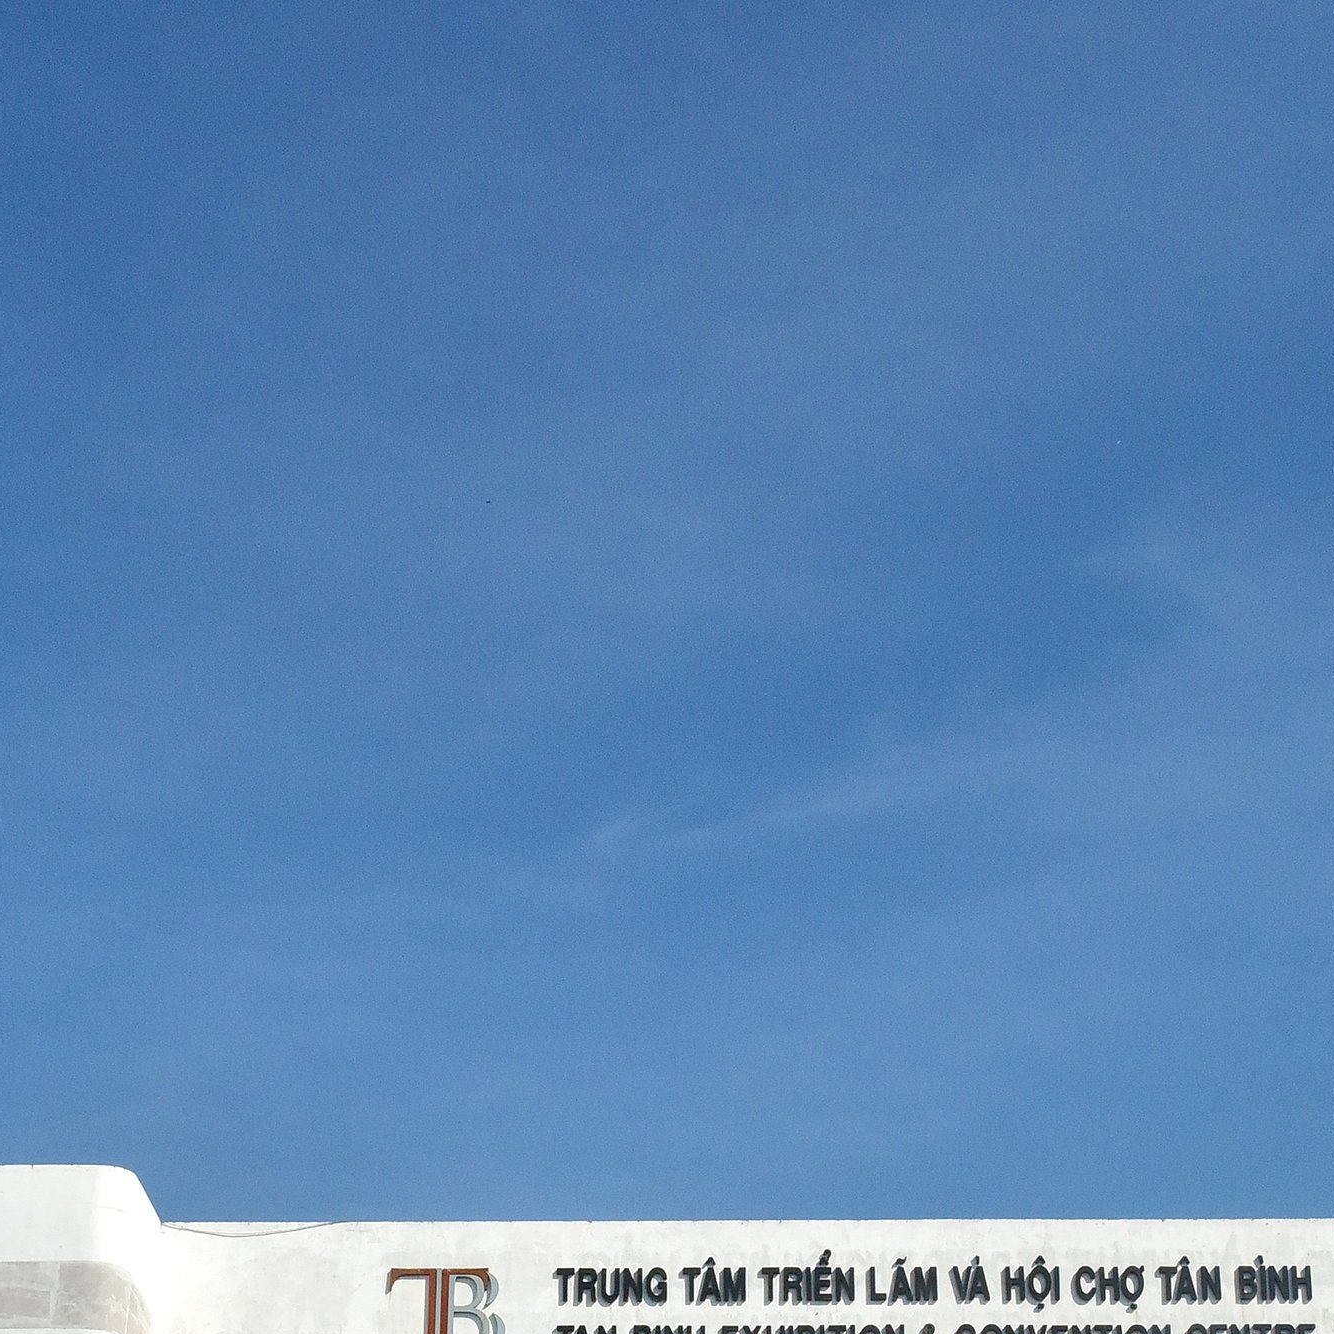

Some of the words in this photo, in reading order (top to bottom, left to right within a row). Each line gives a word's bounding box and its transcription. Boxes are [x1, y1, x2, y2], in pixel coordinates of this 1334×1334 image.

[552, 1266, 668, 1307] TRUNG
[678, 1256, 747, 1307] TÂM
[757, 1249, 856, 1307] TRIỂN
[867, 1256, 939, 1307] LÃM
[1000, 1256, 1060, 1313] HỘI
[1071, 1265, 1145, 1313] CHỢ
[1155, 1256, 1223, 1306] TÂN
[1234, 1255, 1313, 1306] BÌNH
